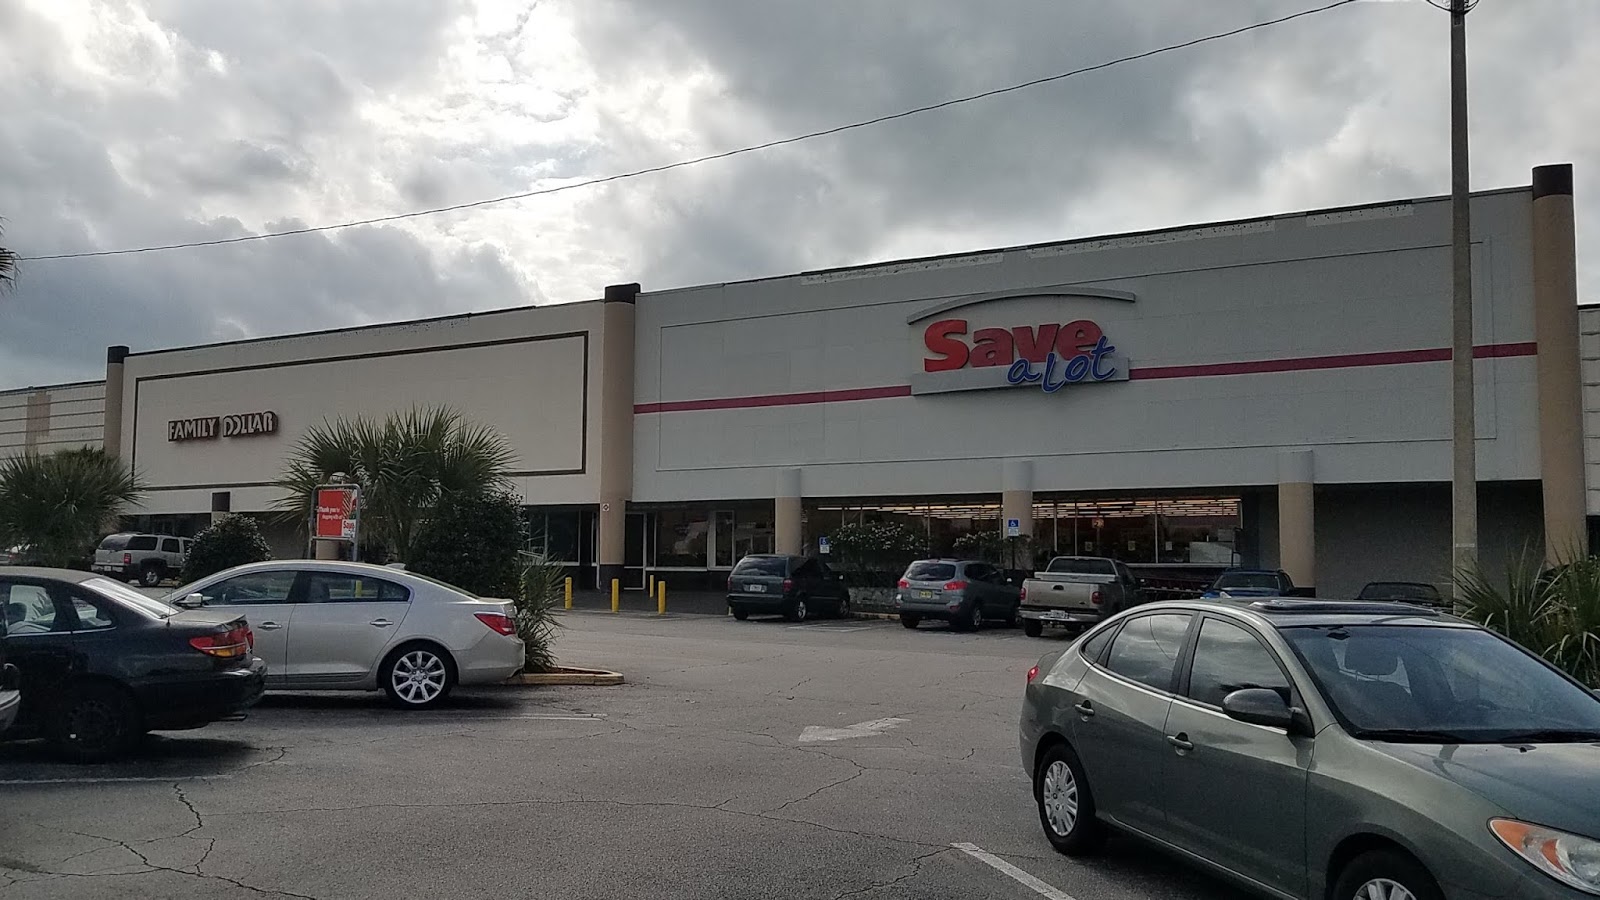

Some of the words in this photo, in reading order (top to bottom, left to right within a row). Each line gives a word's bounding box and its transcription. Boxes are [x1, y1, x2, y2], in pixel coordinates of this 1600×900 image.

[924, 319, 1103, 373] Save
[168, 416, 220, 442] FAMILY
[223, 411, 278, 438] DOLLAR
